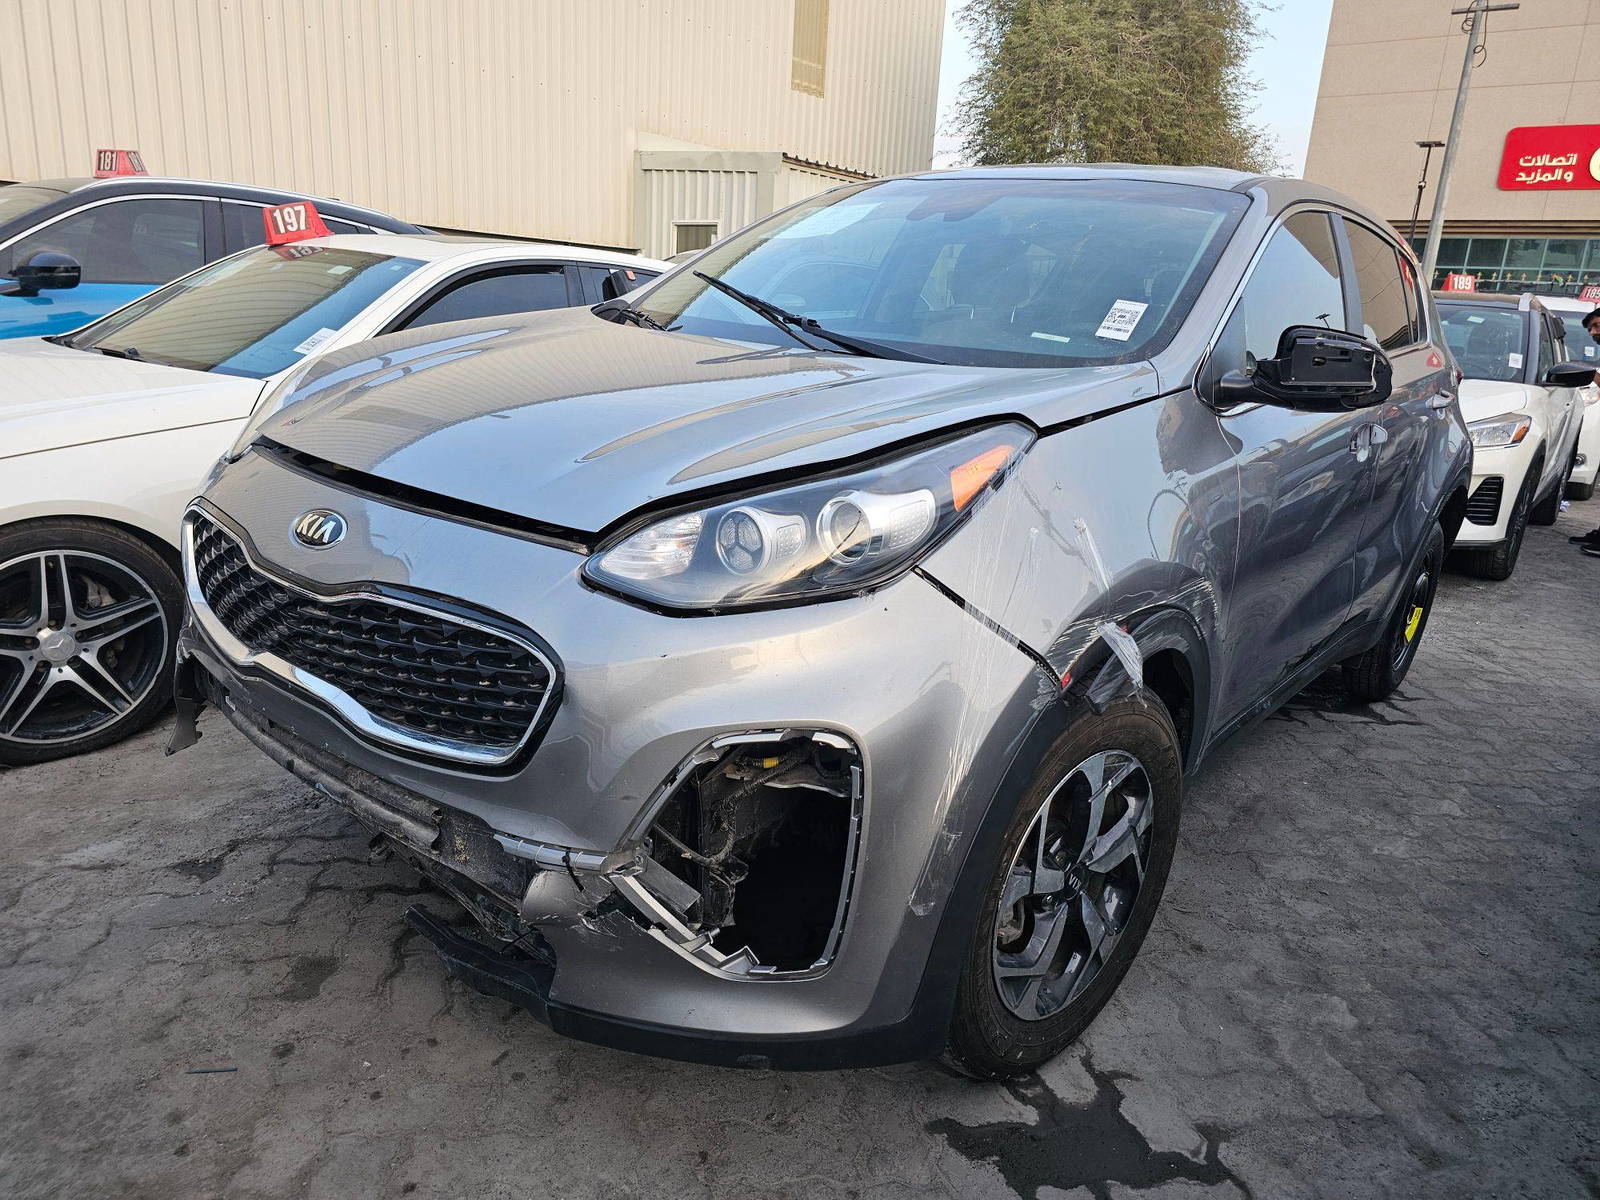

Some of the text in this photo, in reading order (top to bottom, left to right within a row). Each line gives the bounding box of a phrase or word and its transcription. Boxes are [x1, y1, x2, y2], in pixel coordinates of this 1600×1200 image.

[100, 151, 117, 171] 181
[1519, 153, 1578, 167] اتصالات
[1515, 168, 1574, 184] والمزيد
[273, 205, 306, 234] 197
[1453, 276, 1472, 290] 189
[297, 514, 336, 543] KIA
